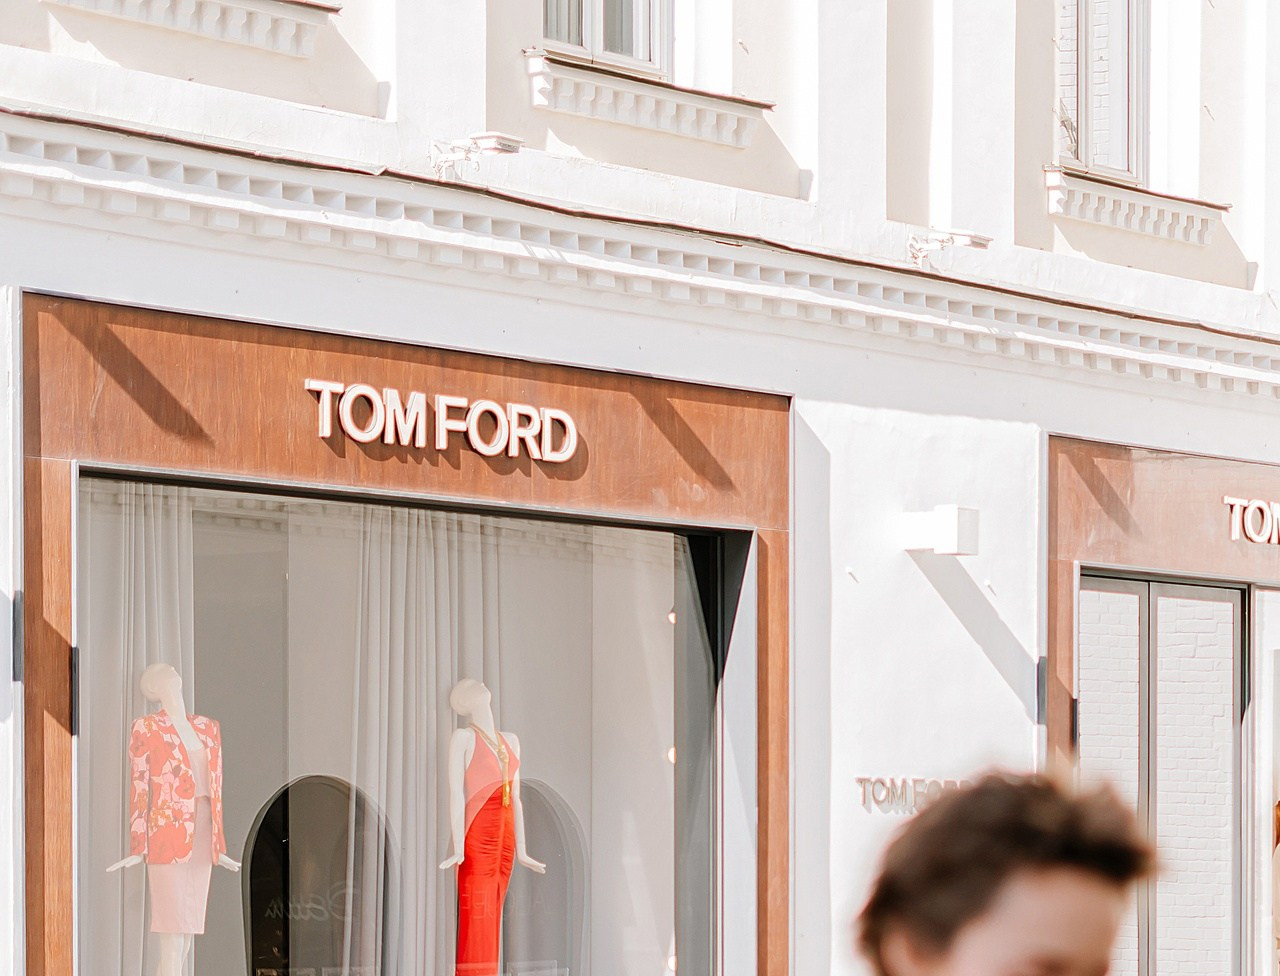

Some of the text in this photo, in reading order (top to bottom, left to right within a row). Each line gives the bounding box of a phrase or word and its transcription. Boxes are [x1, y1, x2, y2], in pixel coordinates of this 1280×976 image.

[305, 378, 578, 463] TOM FORD
[855, 777, 974, 808] TOM FO
